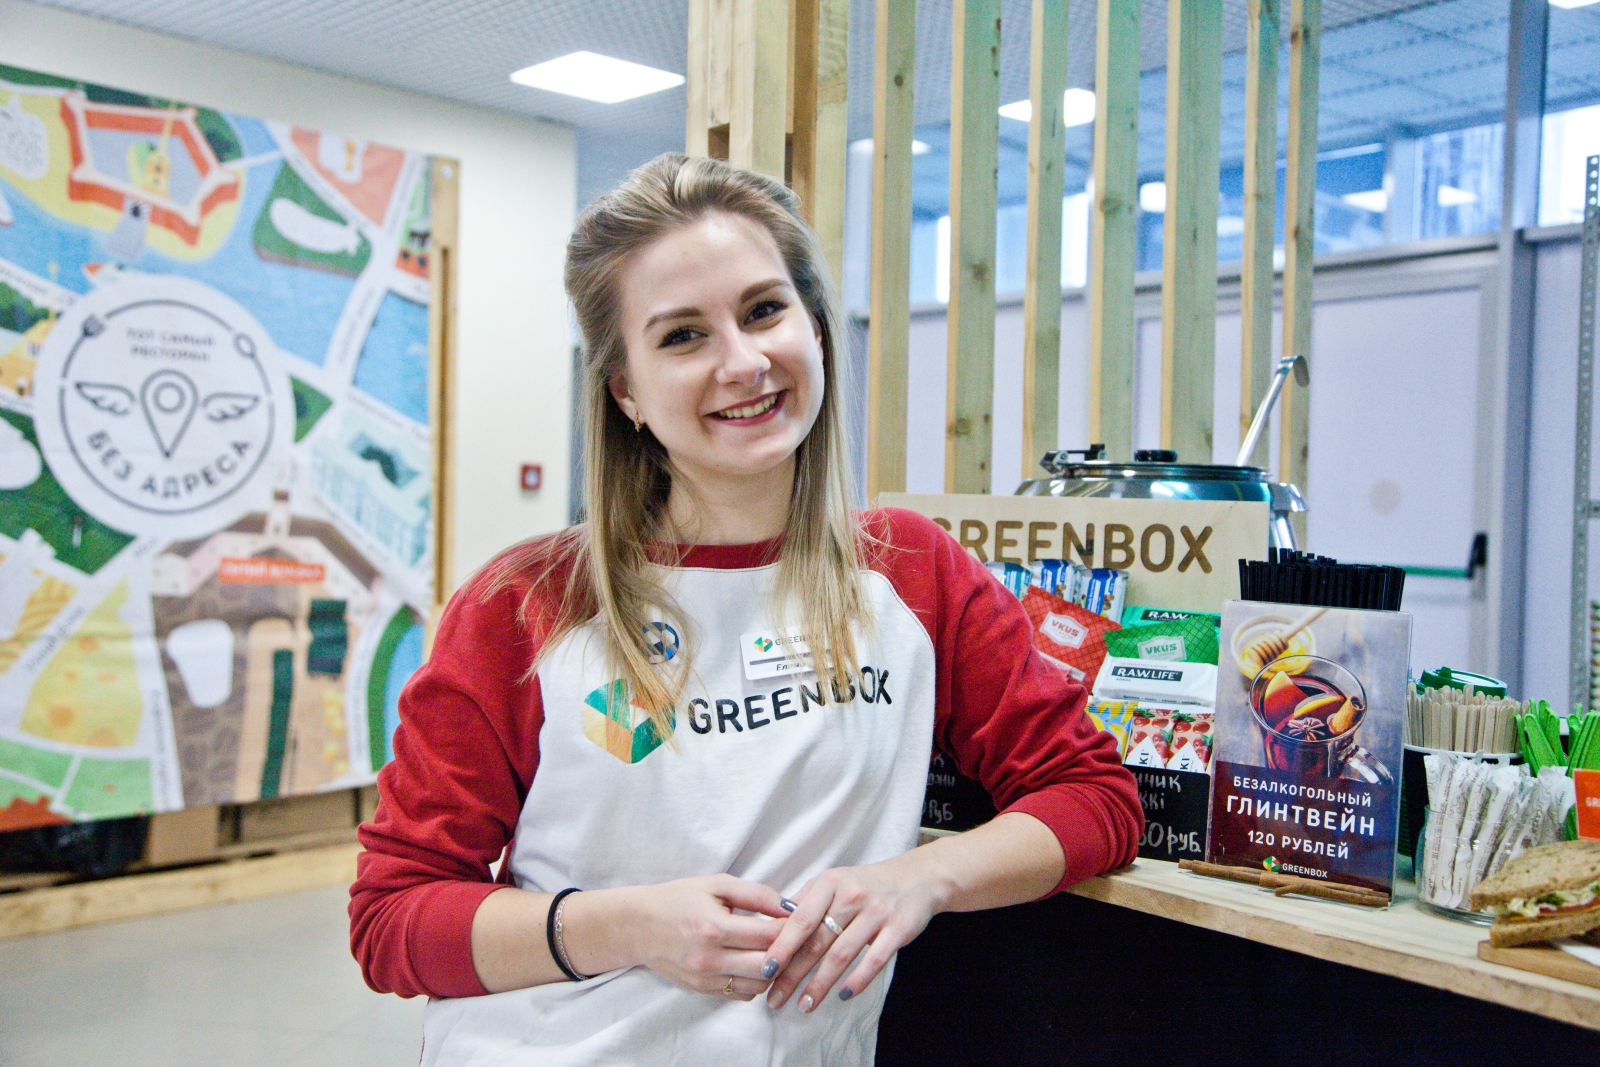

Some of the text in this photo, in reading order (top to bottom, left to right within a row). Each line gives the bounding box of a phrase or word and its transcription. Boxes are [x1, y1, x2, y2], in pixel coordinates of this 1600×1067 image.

[87, 429, 250, 499] БЕЗ АДРЕСА
[933, 516, 1213, 574] REENBOX
[1051, 619, 1080, 637] VKUS
[1145, 643, 1178, 655] VKUS
[688, 666, 893, 735] GREENBOX
[1233, 775, 1372, 808] БЕЗАЛКОГОЛЬНЫЙ
[1226, 794, 1375, 836] ГЛИНТВЕЙН
[1248, 830, 1349, 860] 120 РУБЛЕЙ
[1282, 863, 1328, 879] GREENBOX
